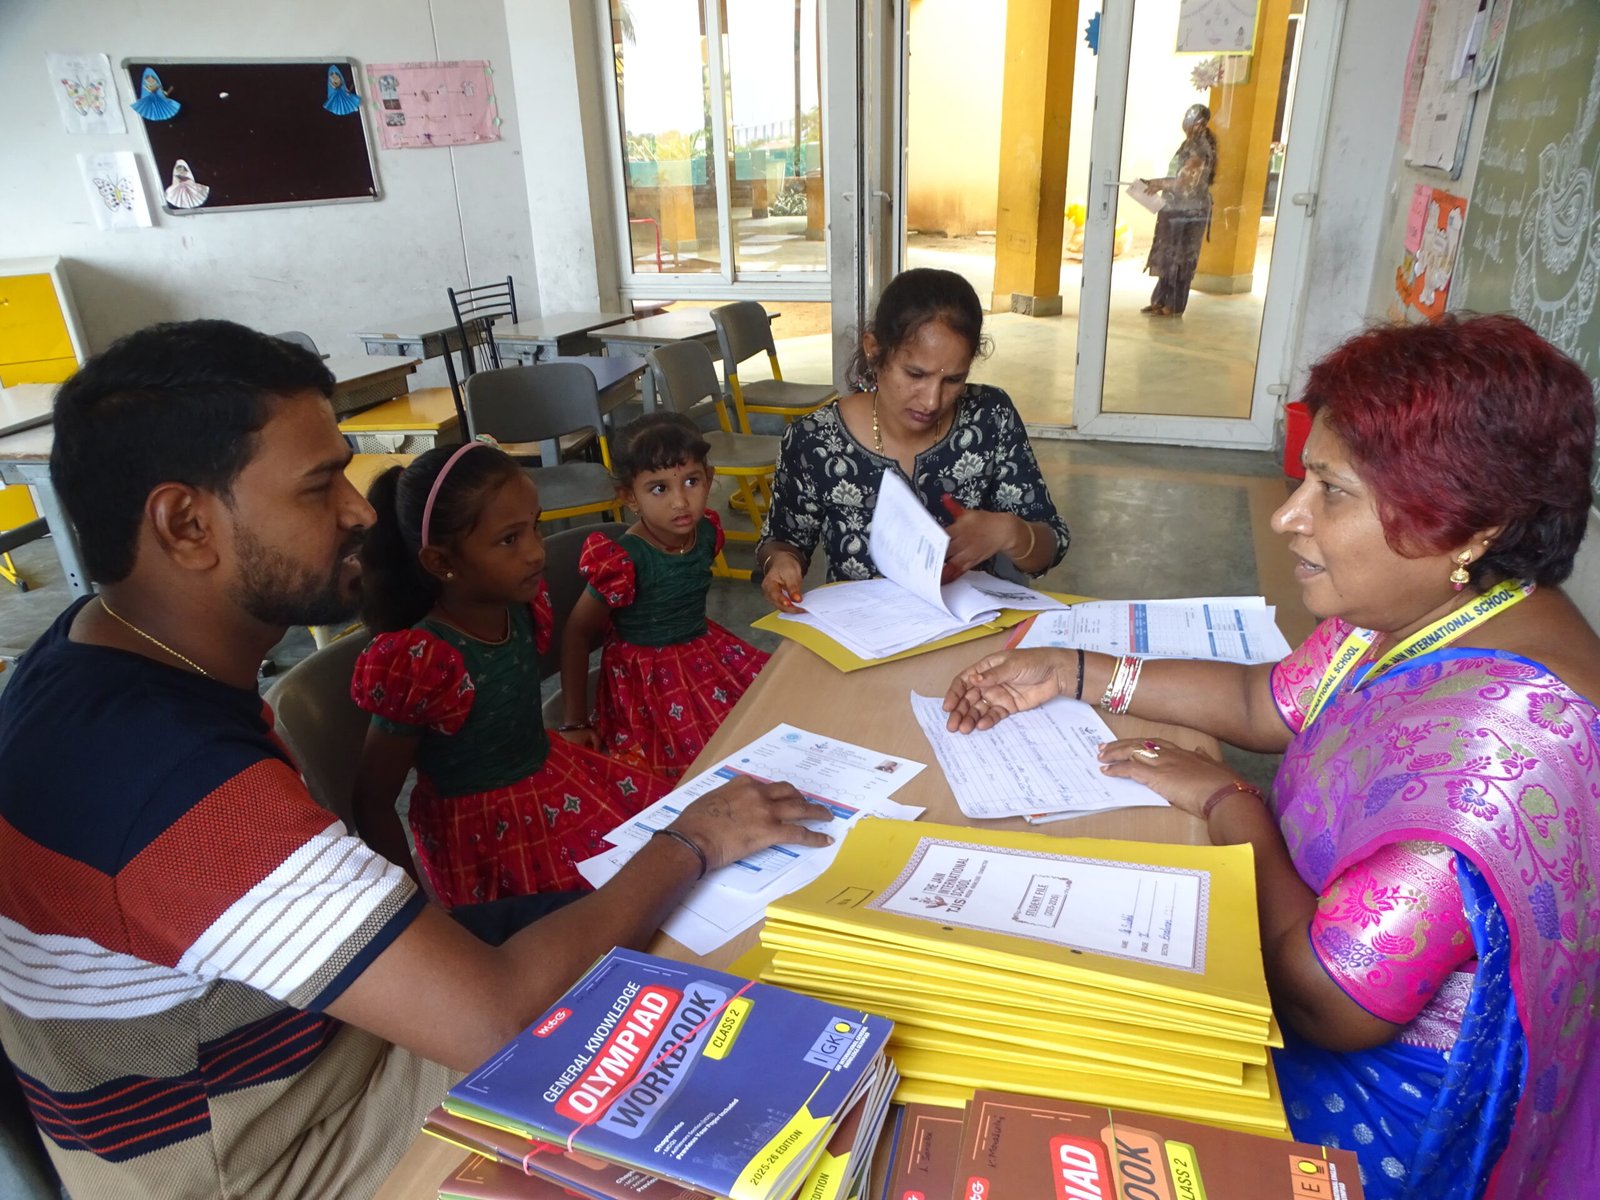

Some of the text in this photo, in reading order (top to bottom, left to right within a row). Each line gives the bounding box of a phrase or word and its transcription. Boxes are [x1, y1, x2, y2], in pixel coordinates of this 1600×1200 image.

[1406, 612, 1475, 657] INTERNATIONAL
[1473, 589, 1515, 616] SCHOOL
[1334, 645, 1360, 675] SCHOOL
[938, 858, 969, 894] INTERNATIONAL
[950, 879, 971, 896] SCHOOL
[946, 898, 967, 912] TJIS
[1026, 884, 1048, 917] STUDENT FILE
[543, 1053, 592, 1103] GENERAL
[584, 980, 641, 1053] KNOWLEDGE
[712, 1008, 740, 1048] CLASS 2
[568, 991, 669, 1115] OLYMPIAD
[610, 990, 716, 1129] WORKBOOK
[750, 1129, 803, 1186] 2025-26 EDITION
[1059, 1144, 1102, 1200] IAD
[1174, 1158, 1188, 1168] 2
